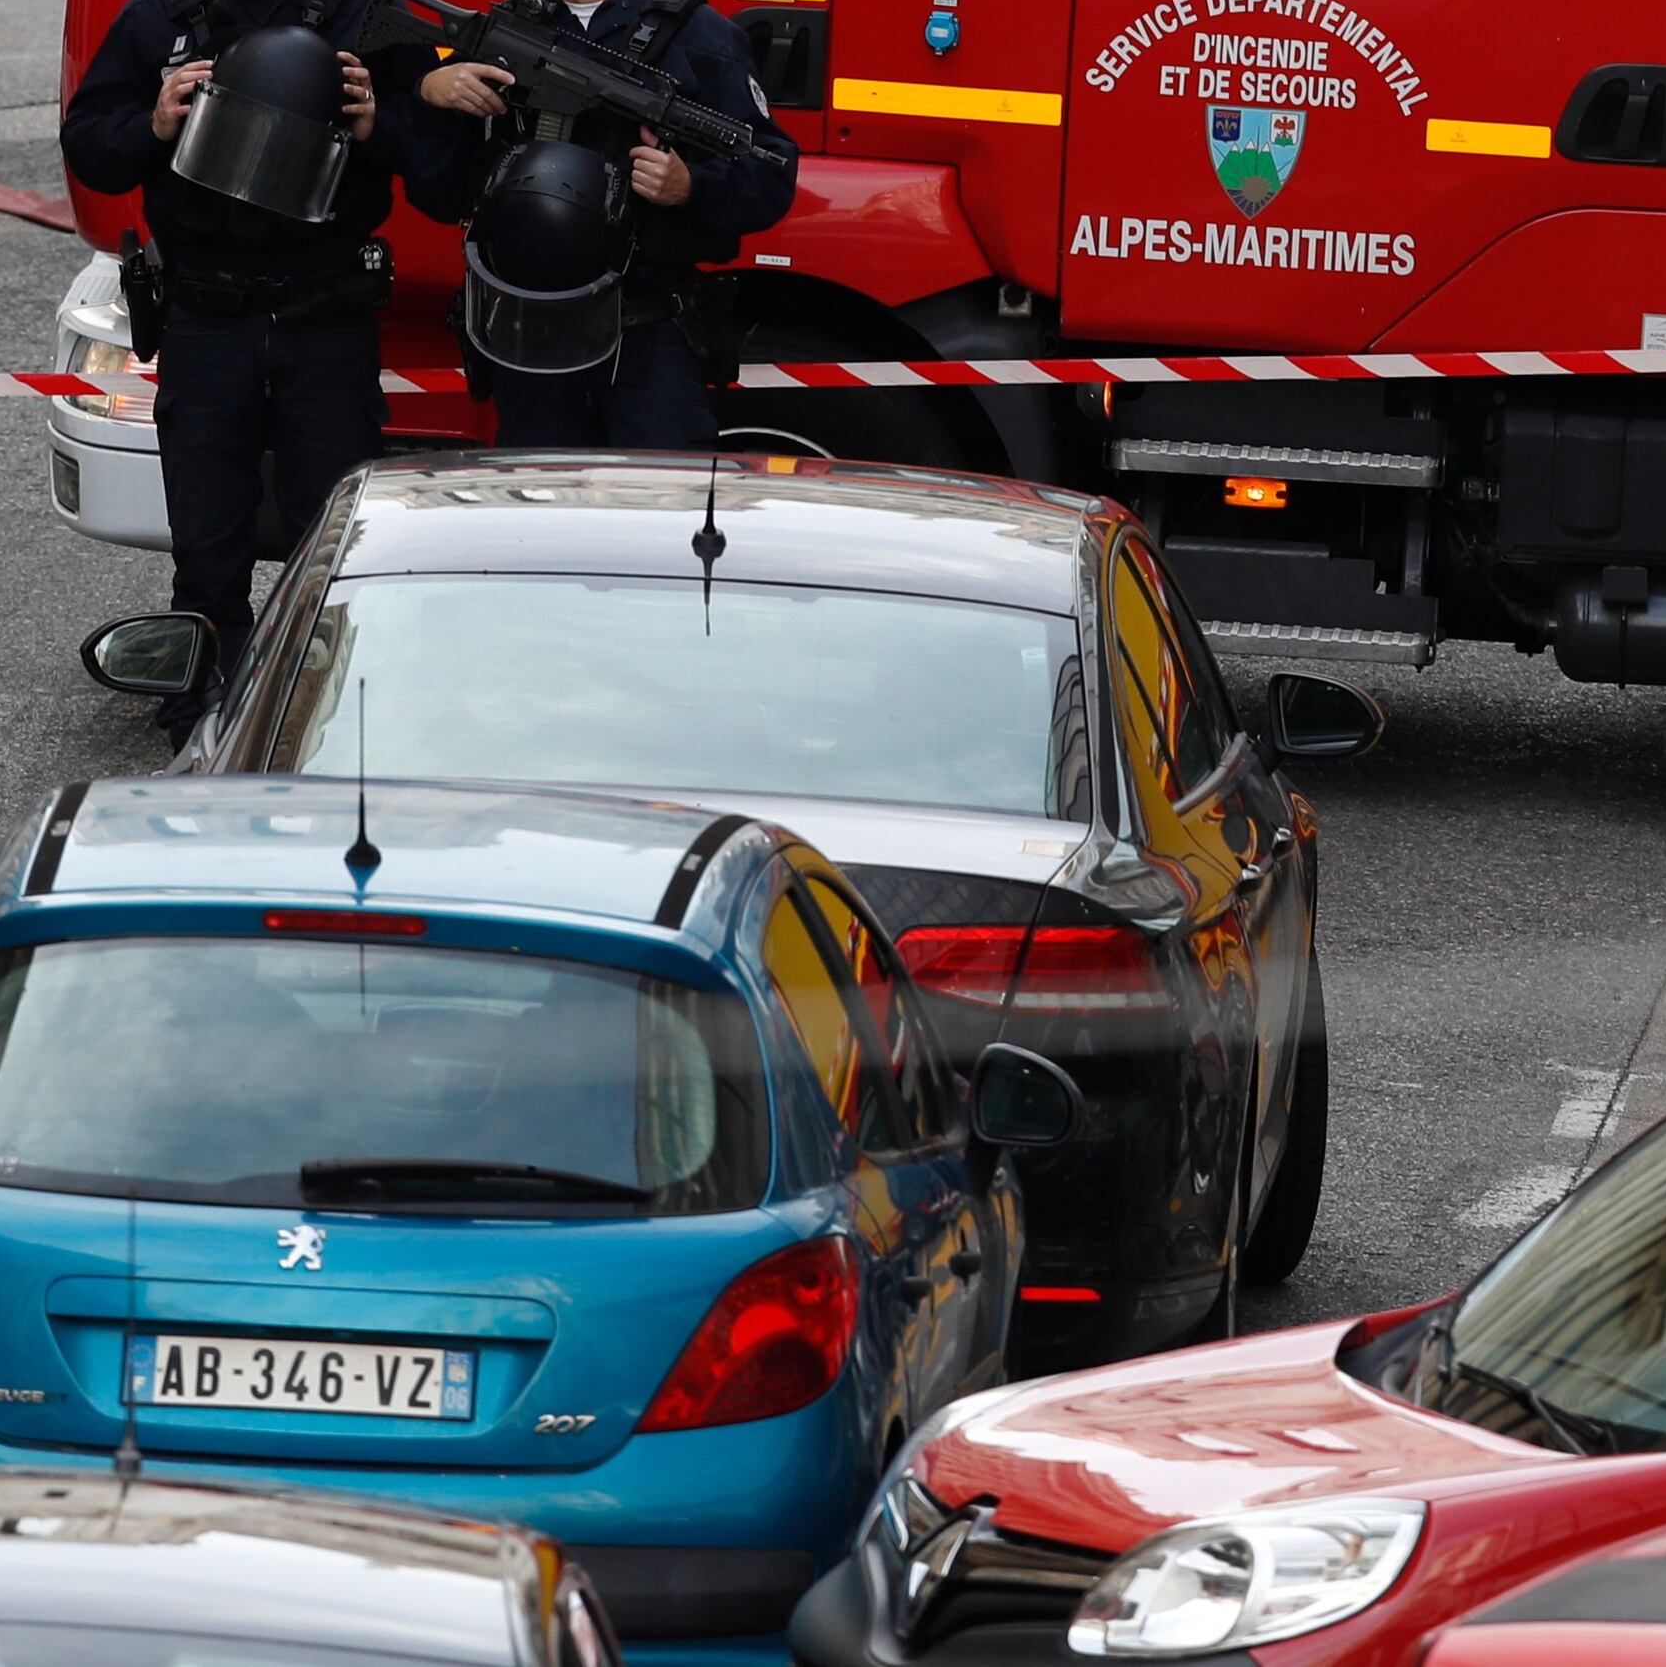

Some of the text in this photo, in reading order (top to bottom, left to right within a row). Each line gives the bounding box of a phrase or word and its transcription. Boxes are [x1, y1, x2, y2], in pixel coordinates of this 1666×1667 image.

[1192, 33, 1330, 72] D'INCENDIE
[1159, 65, 1358, 110] ET DE SECOURS
[1070, 215, 1416, 276] ALPES-MARITIMES
[159, 1344, 436, 1409] AB-346-VZ
[444, 1386, 470, 1410] 06
[533, 1413, 597, 1434] 207
